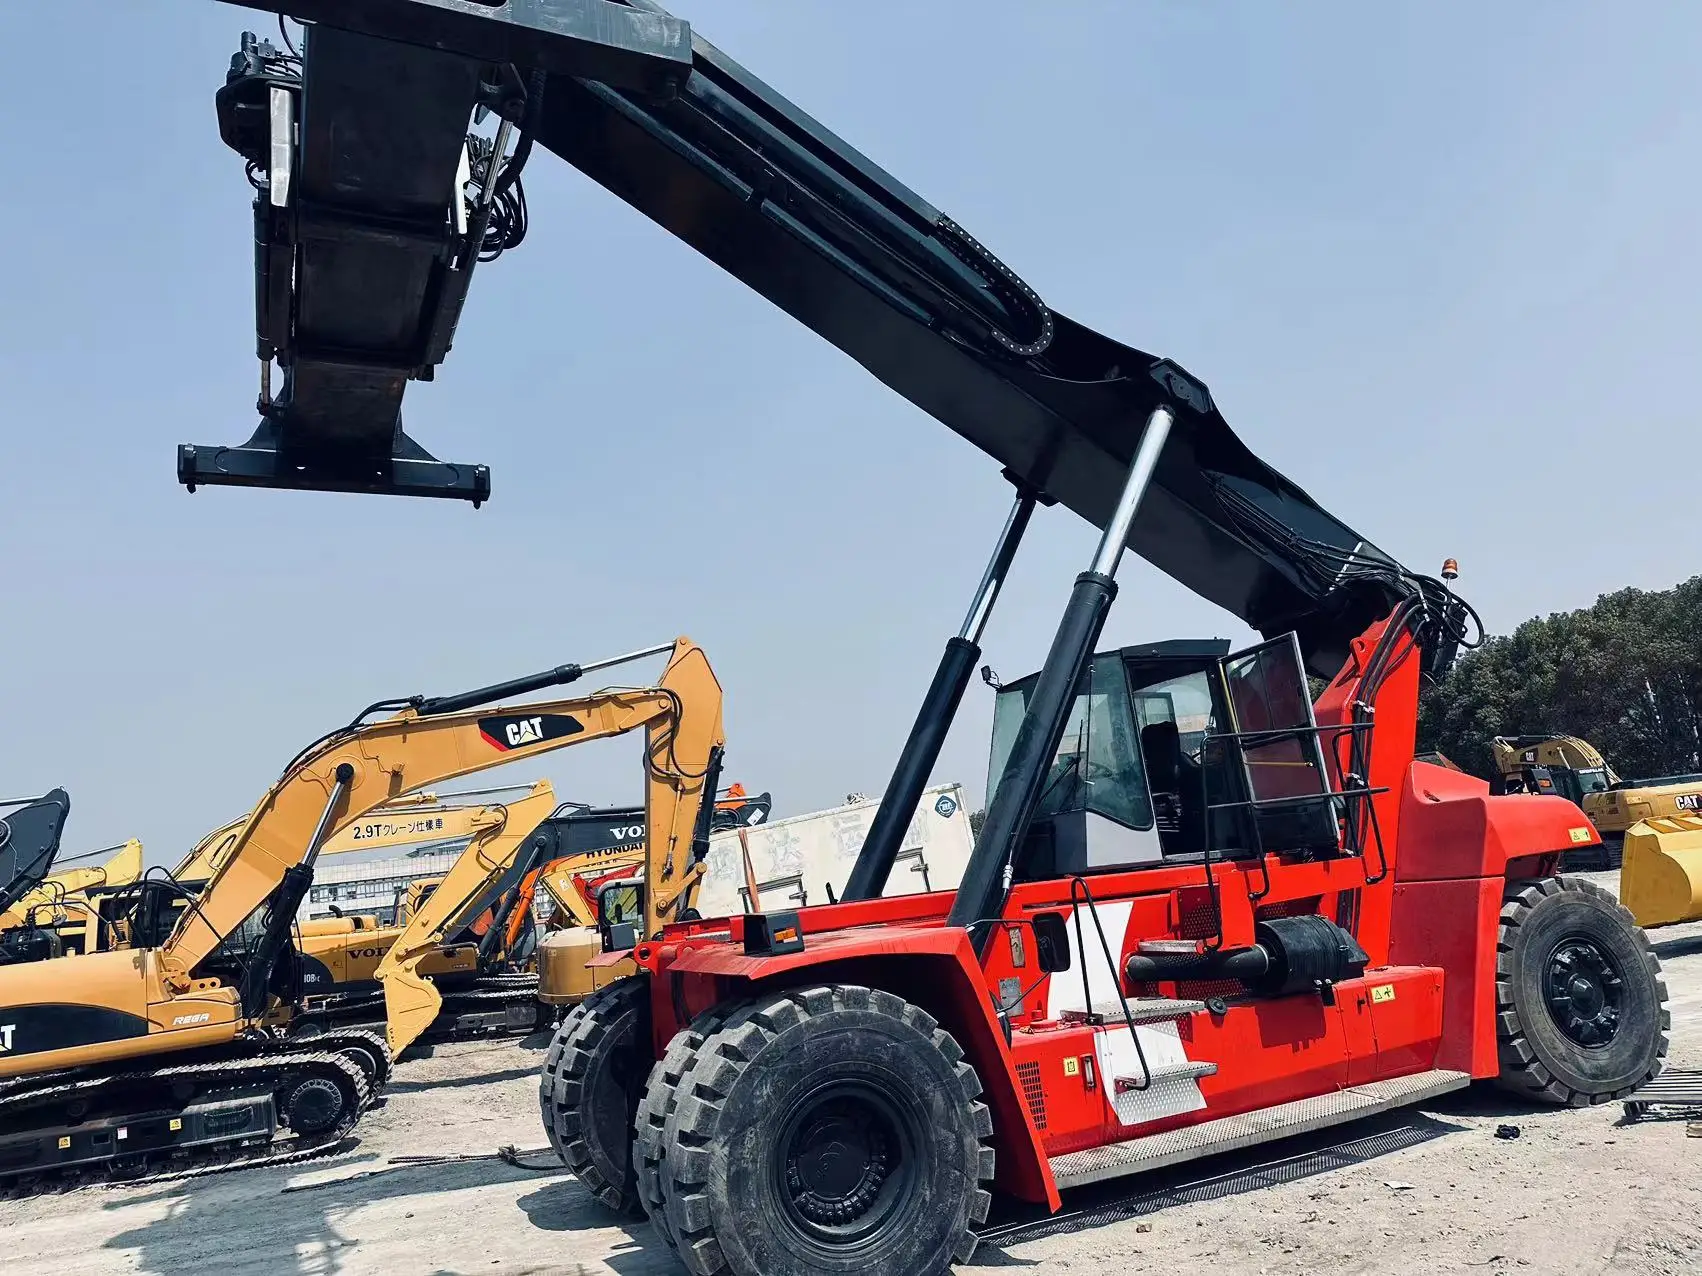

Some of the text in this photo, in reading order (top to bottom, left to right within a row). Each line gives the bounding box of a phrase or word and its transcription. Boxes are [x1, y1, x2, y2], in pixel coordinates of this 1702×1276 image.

[505, 717, 543, 746] CAT
[1675, 795, 1699, 810] CAT
[586, 842, 644, 859] HYUNDAI
[172, 1012, 210, 1026] REGA
